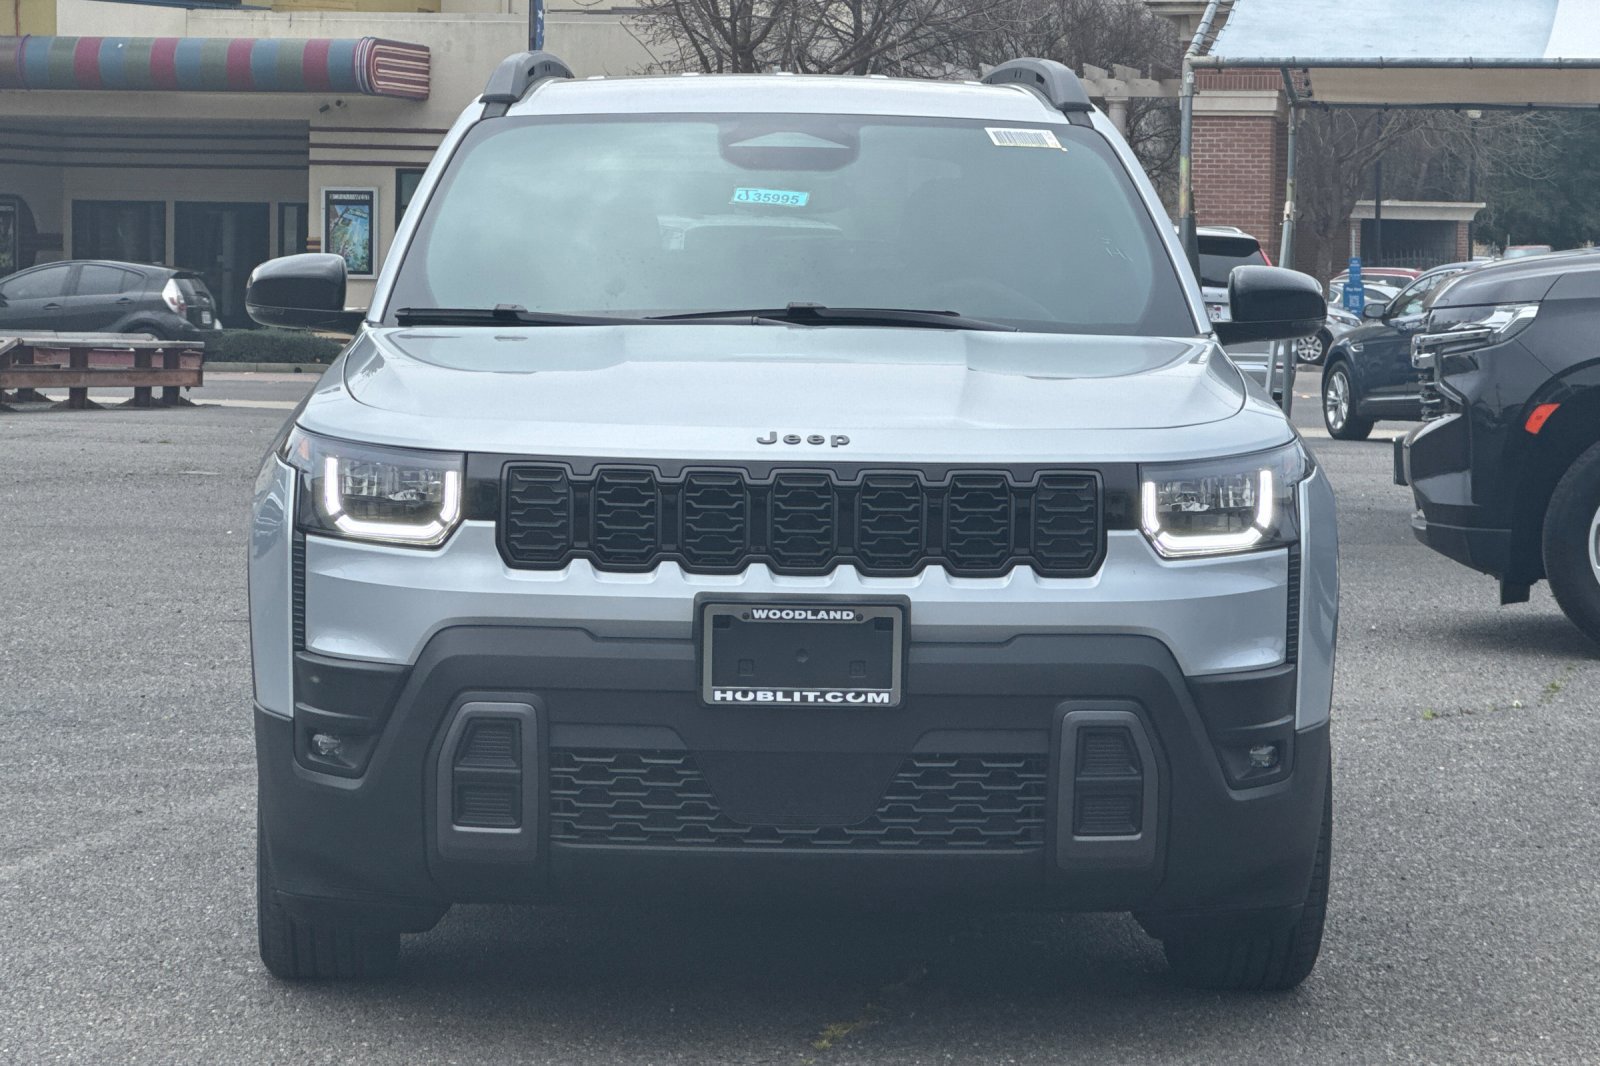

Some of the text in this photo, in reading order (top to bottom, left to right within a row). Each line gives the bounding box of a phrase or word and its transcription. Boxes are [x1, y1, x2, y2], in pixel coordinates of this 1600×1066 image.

[756, 431, 850, 447] Jeep
[752, 608, 855, 620] WOODLAND
[713, 690, 890, 704] HUBLIT.COM
